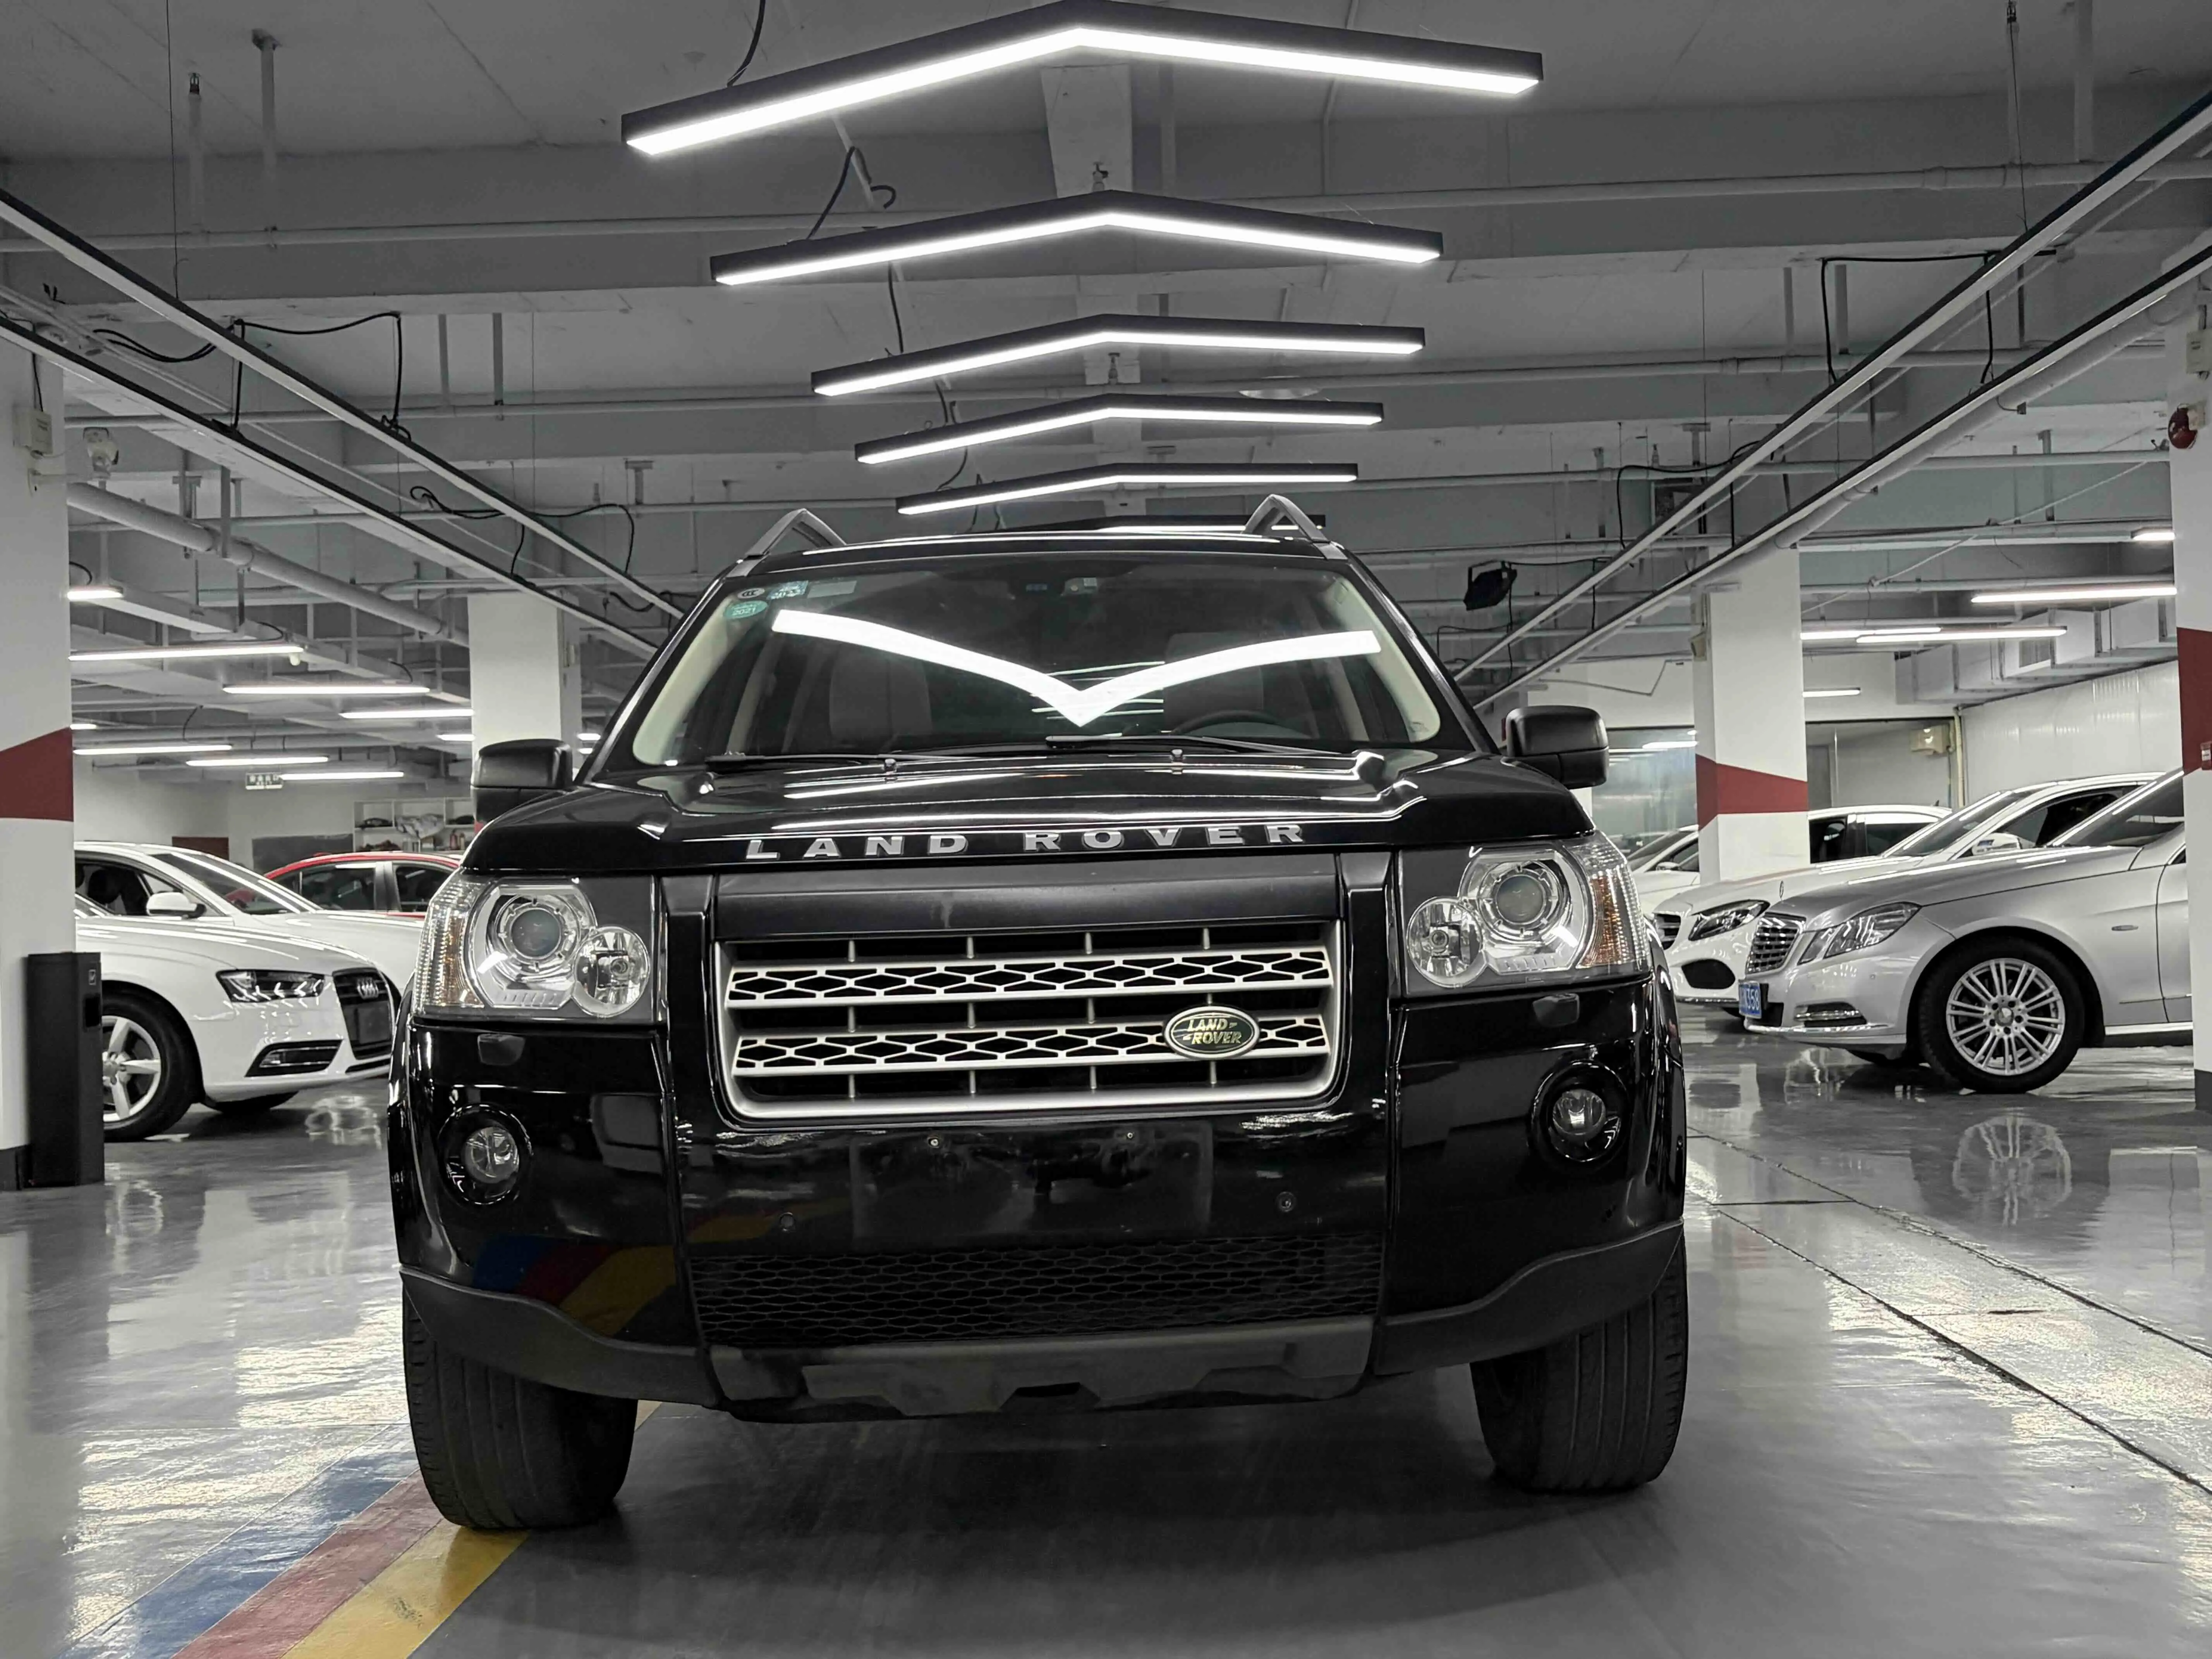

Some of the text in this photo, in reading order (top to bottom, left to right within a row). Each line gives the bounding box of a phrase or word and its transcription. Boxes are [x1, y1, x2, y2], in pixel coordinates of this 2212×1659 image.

[746, 824, 1304, 859] LAND ROVER
[1187, 1018, 1228, 1032] LAND
[1191, 1031, 1242, 1044] ROVER
